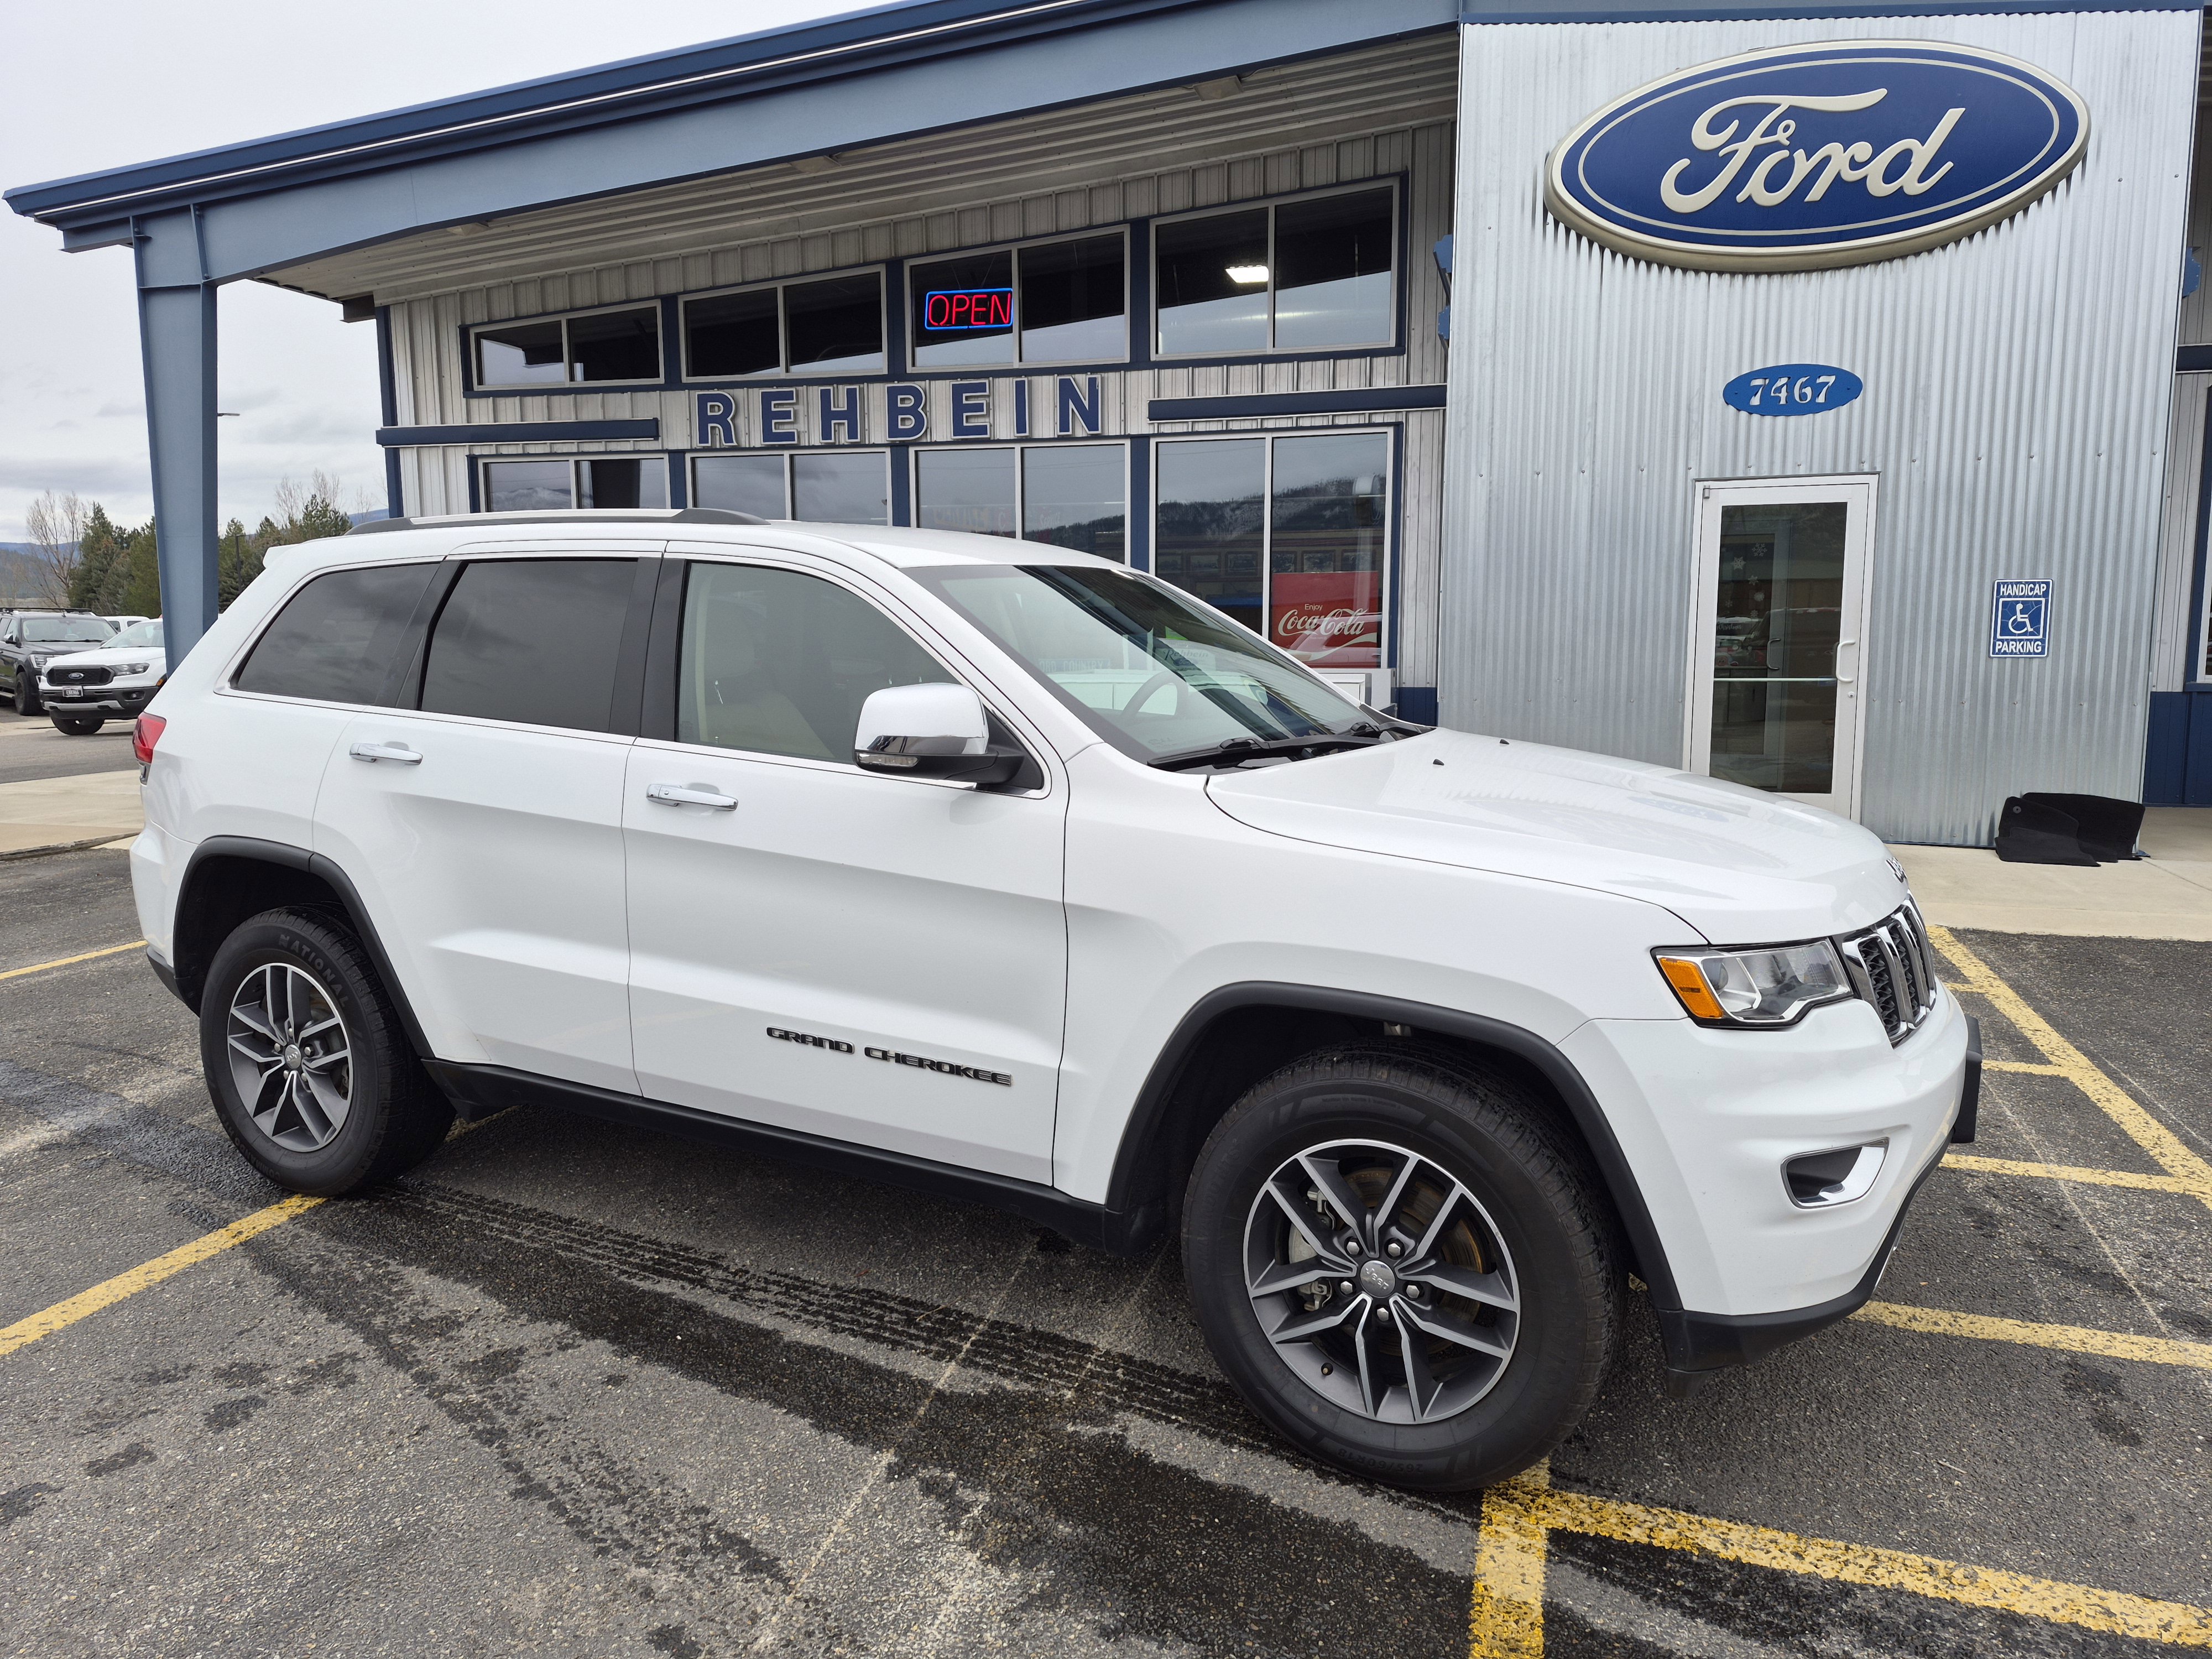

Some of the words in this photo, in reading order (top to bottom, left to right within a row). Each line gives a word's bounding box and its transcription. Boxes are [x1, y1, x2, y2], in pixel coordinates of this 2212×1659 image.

[1660, 87, 1966, 213] Ford
[928, 293, 1011, 326] OPEN
[1749, 374, 1836, 406] 7467
[696, 374, 1102, 447] REHBEIN
[2000, 583, 2047, 596] HANDICAP
[1277, 608, 1368, 637] Coca-Cola
[1995, 641, 2042, 653] PARKING
[1039, 660, 1057, 673] ORD
[278, 934, 349, 1008] NATIONAL
[766, 1025, 855, 1055] GRAND
[864, 1045, 1013, 1087] CHEROKEE
[1365, 1267, 1389, 1290] Jeep
[1337, 1448, 1424, 1474] 265/60R18
